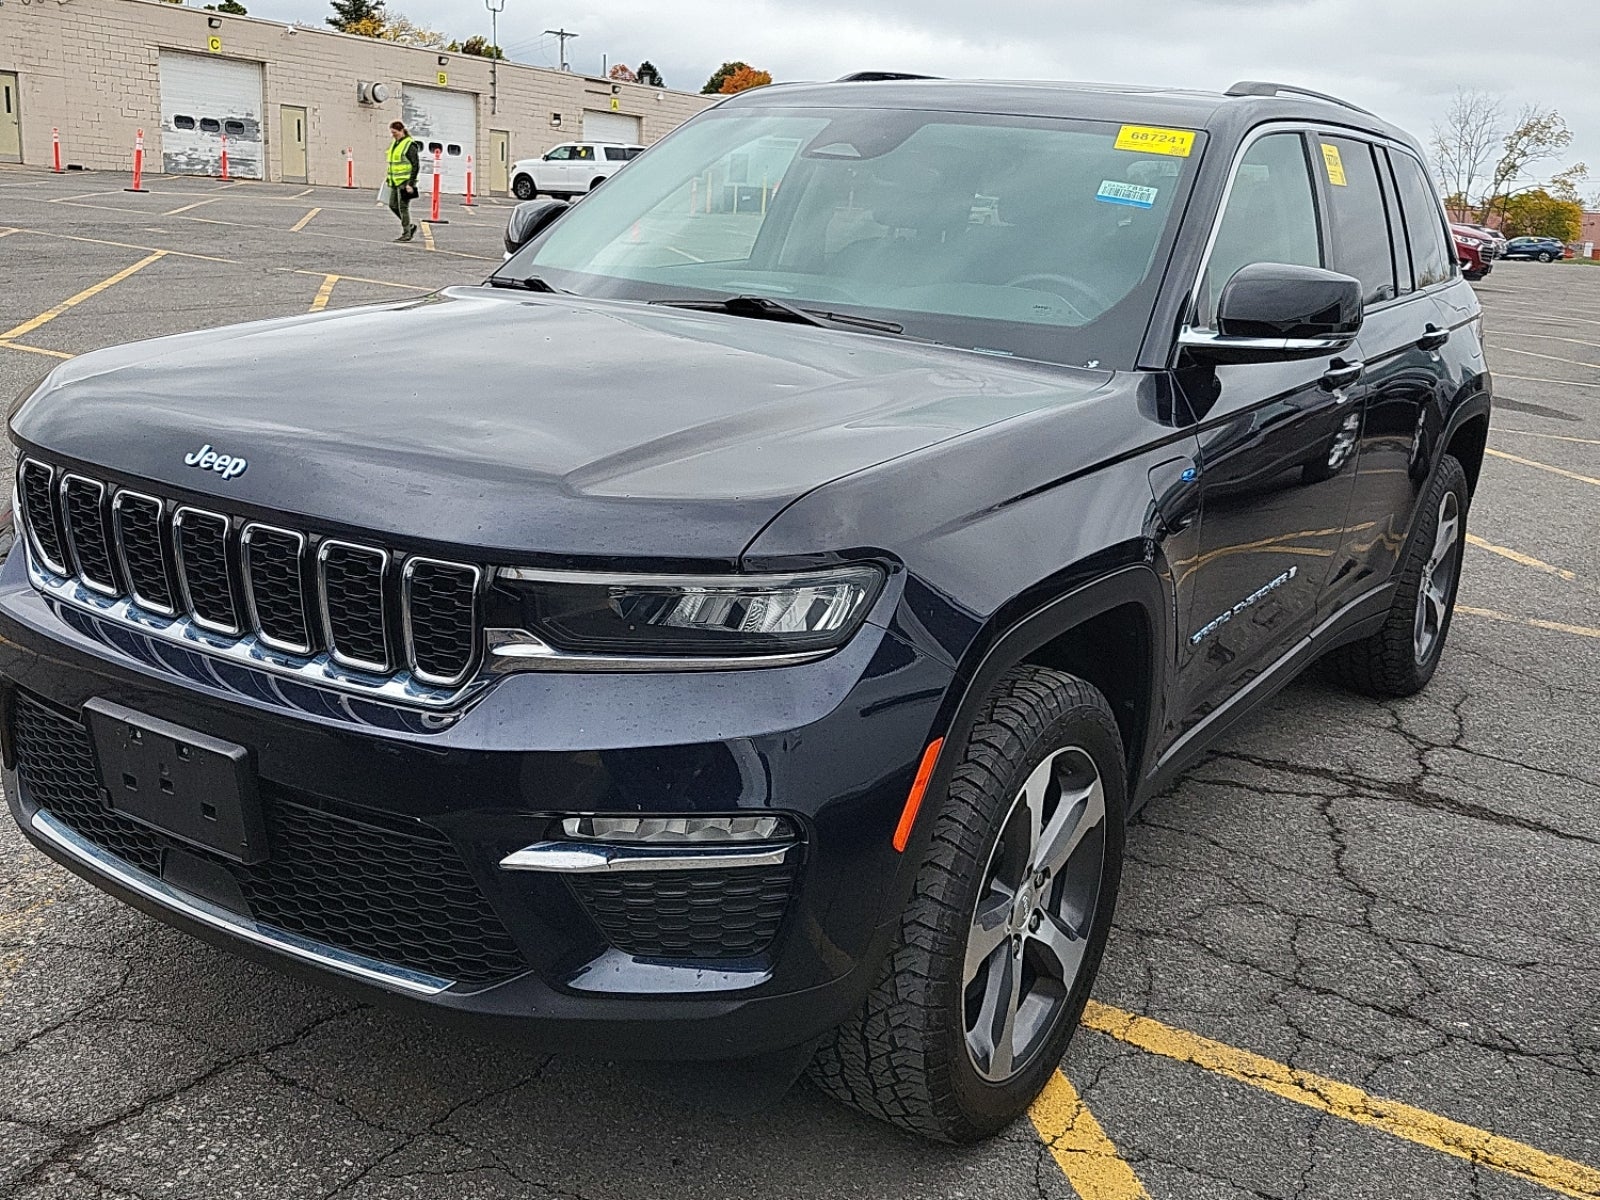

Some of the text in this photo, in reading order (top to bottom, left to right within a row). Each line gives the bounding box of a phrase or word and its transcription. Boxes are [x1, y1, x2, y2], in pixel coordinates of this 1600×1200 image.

[210, 38, 219, 49] C
[439, 74, 446, 84] B
[612, 101, 618, 109] A
[1131, 131, 1185, 144] 687241
[184, 444, 248, 480] Jeep
